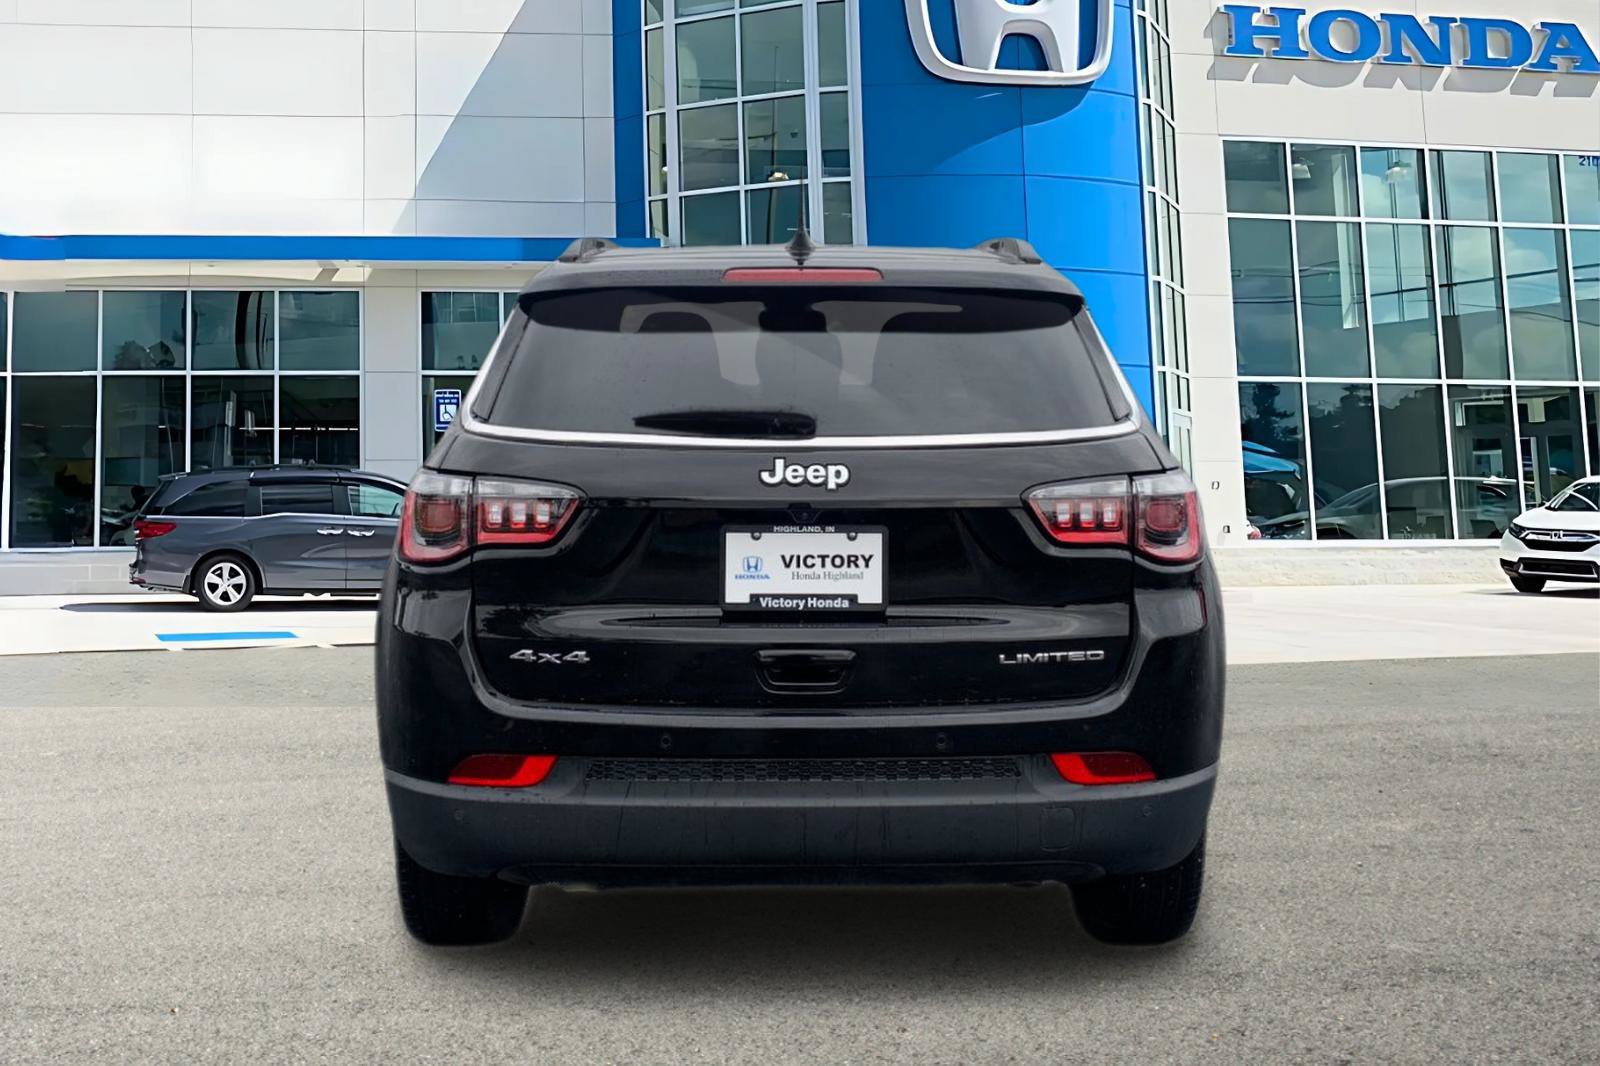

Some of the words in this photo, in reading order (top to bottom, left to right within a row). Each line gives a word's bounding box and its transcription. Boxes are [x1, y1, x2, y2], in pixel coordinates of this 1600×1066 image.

[1223, 4, 1600, 74] HONDA
[760, 457, 850, 490] Jeep
[780, 554, 874, 569] VICTORY
[791, 571, 821, 580] Honda
[823, 571, 864, 582] Highland
[759, 597, 806, 610] Victory
[807, 597, 849, 608] Honda
[509, 649, 591, 664] 4x4
[999, 650, 1104, 665] LIMITED
